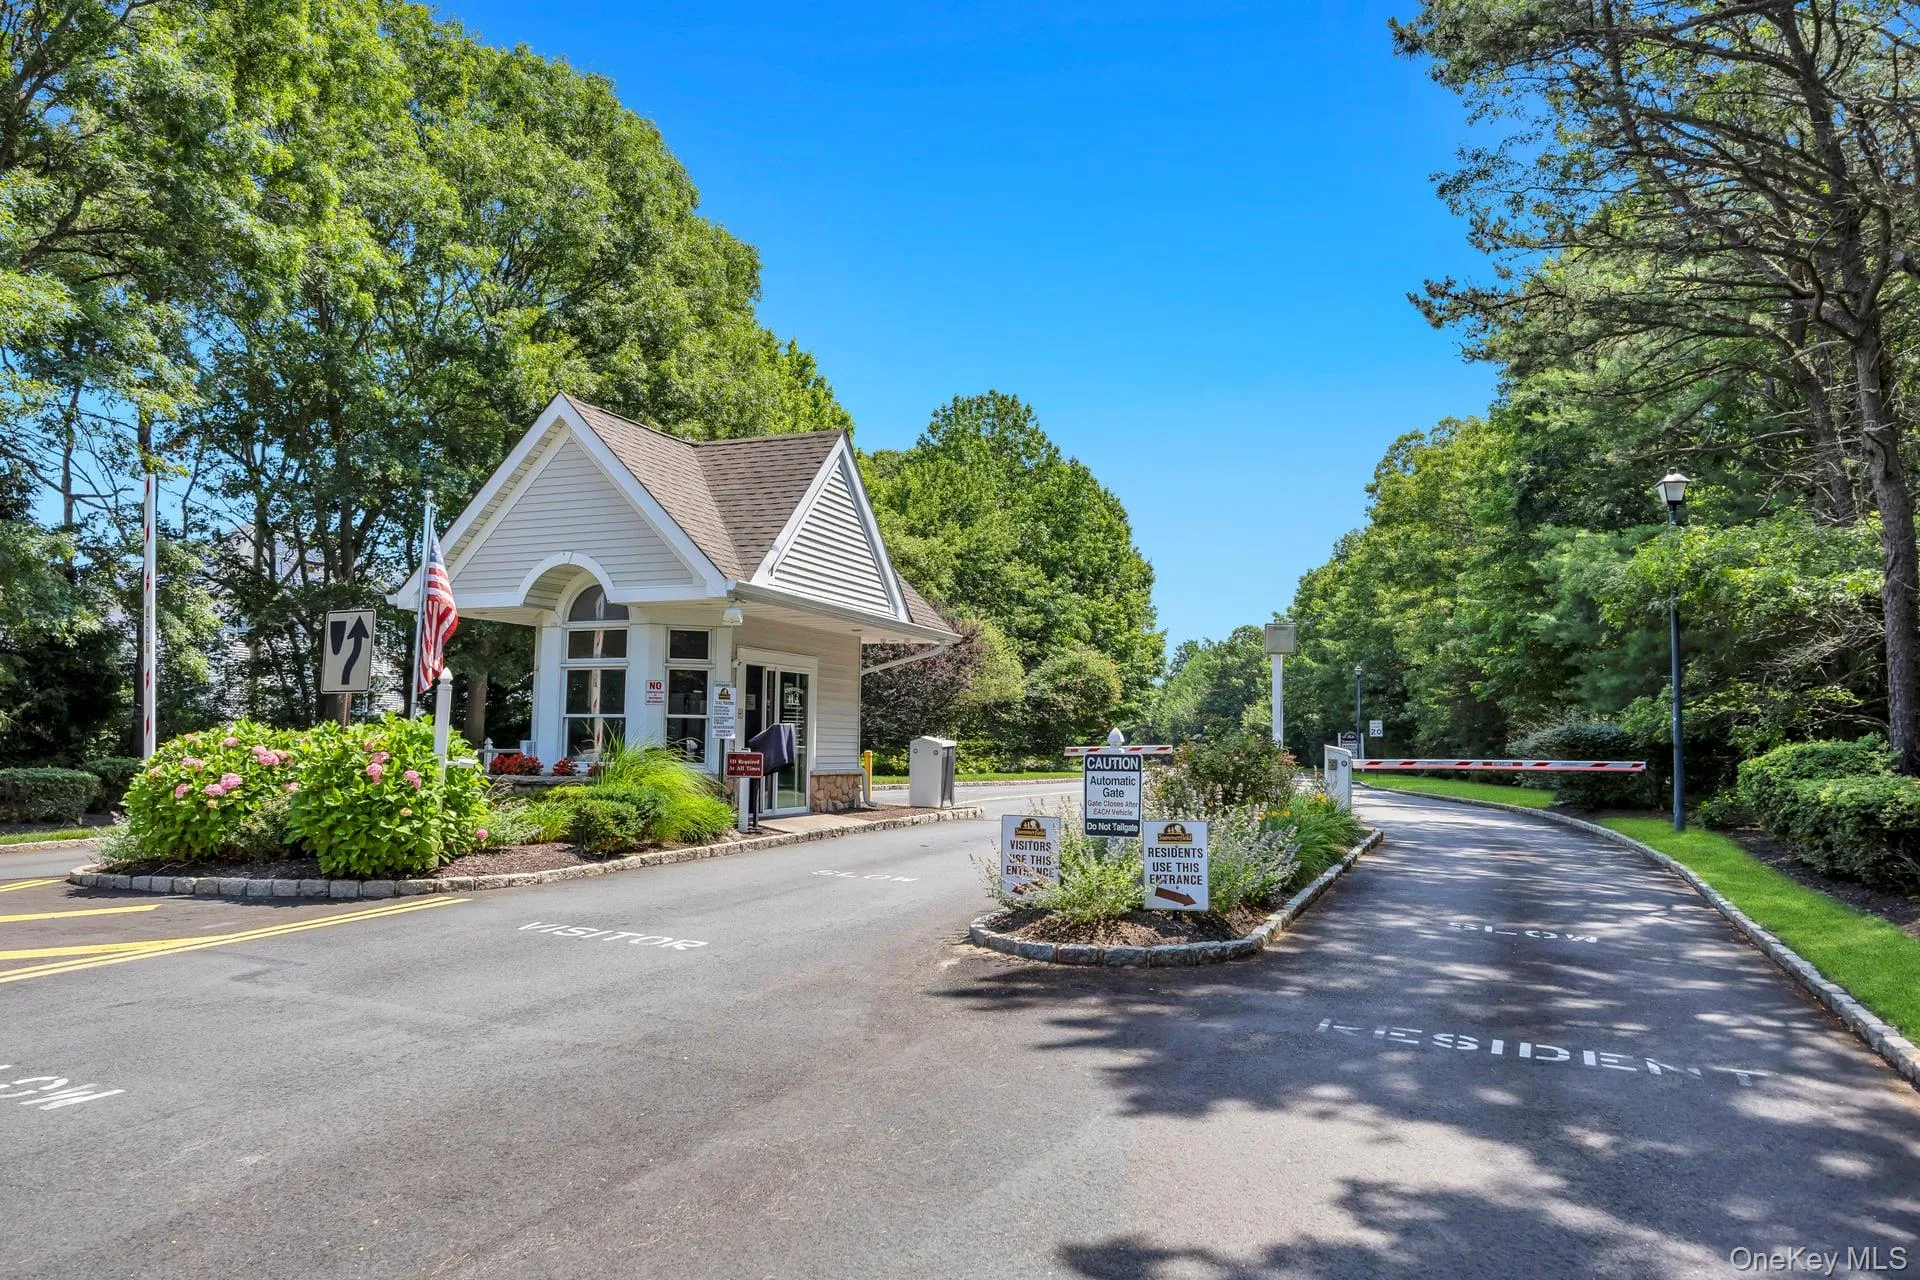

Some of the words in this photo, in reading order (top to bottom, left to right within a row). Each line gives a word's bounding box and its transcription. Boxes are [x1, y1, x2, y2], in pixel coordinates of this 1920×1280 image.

[649, 681, 662, 690] NO
[1087, 757, 1139, 770] CAUTION
[1090, 776, 1136, 786] Automatic
[1102, 787, 1125, 798] Gate
[1087, 823, 1097, 831] Do
[1098, 823, 1111, 831] Not
[1112, 823, 1139, 833] Tailgate
[1010, 839, 1052, 852] VISITORS
[1148, 847, 1204, 859] RESIDENTS
[1009, 853, 1027, 864] USE
[1030, 854, 1052, 866] THIS
[1152, 862, 1172, 872] USE
[1176, 862, 1200, 873] THIS
[1150, 874, 1203, 885] ENTRANCE
[518, 921, 709, 950] VISITOR
[1448, 922, 1598, 943] SLOW
[1316, 1018, 1769, 1087] RESIDENT
